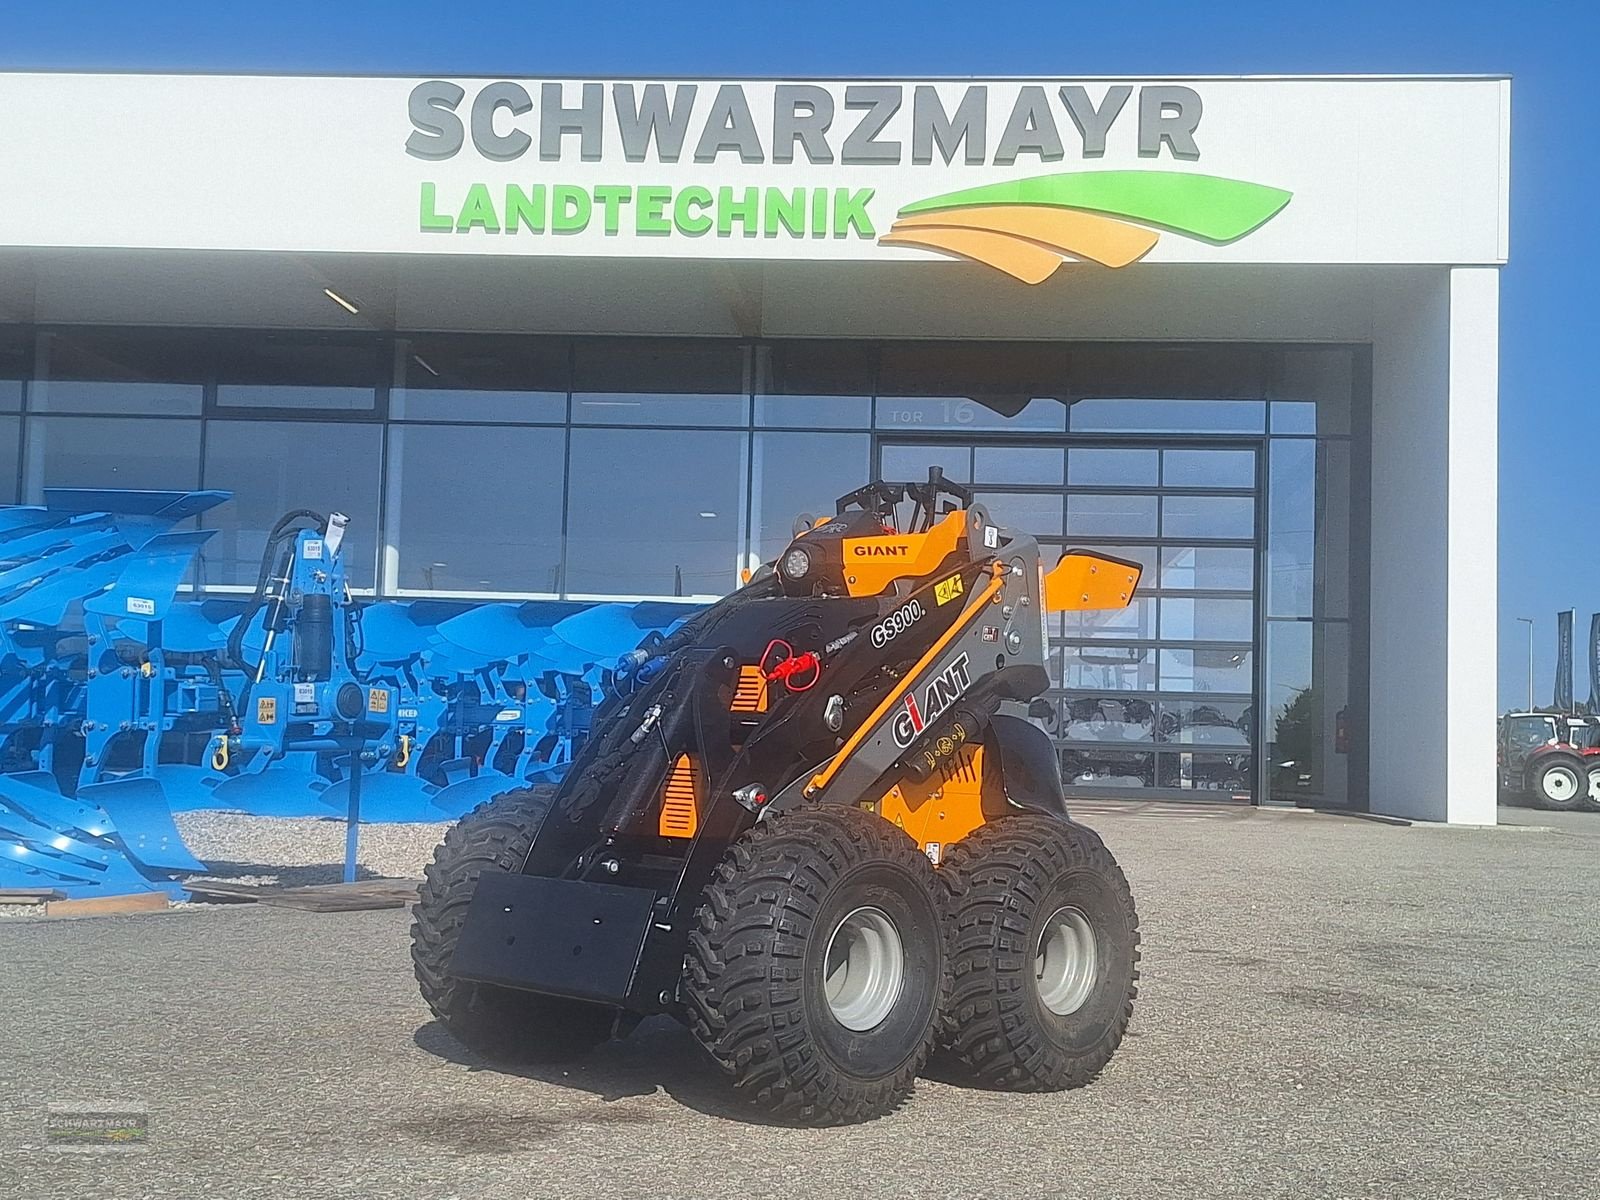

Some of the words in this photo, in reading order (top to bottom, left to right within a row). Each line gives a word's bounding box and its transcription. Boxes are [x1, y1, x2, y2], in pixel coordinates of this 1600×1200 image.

[405, 80, 1203, 167] SCHWARZMAYR
[420, 182, 876, 239] LANDTECHNIK
[890, 410, 923, 423] TOR
[940, 400, 975, 424] 16
[854, 545, 909, 556] GIANT
